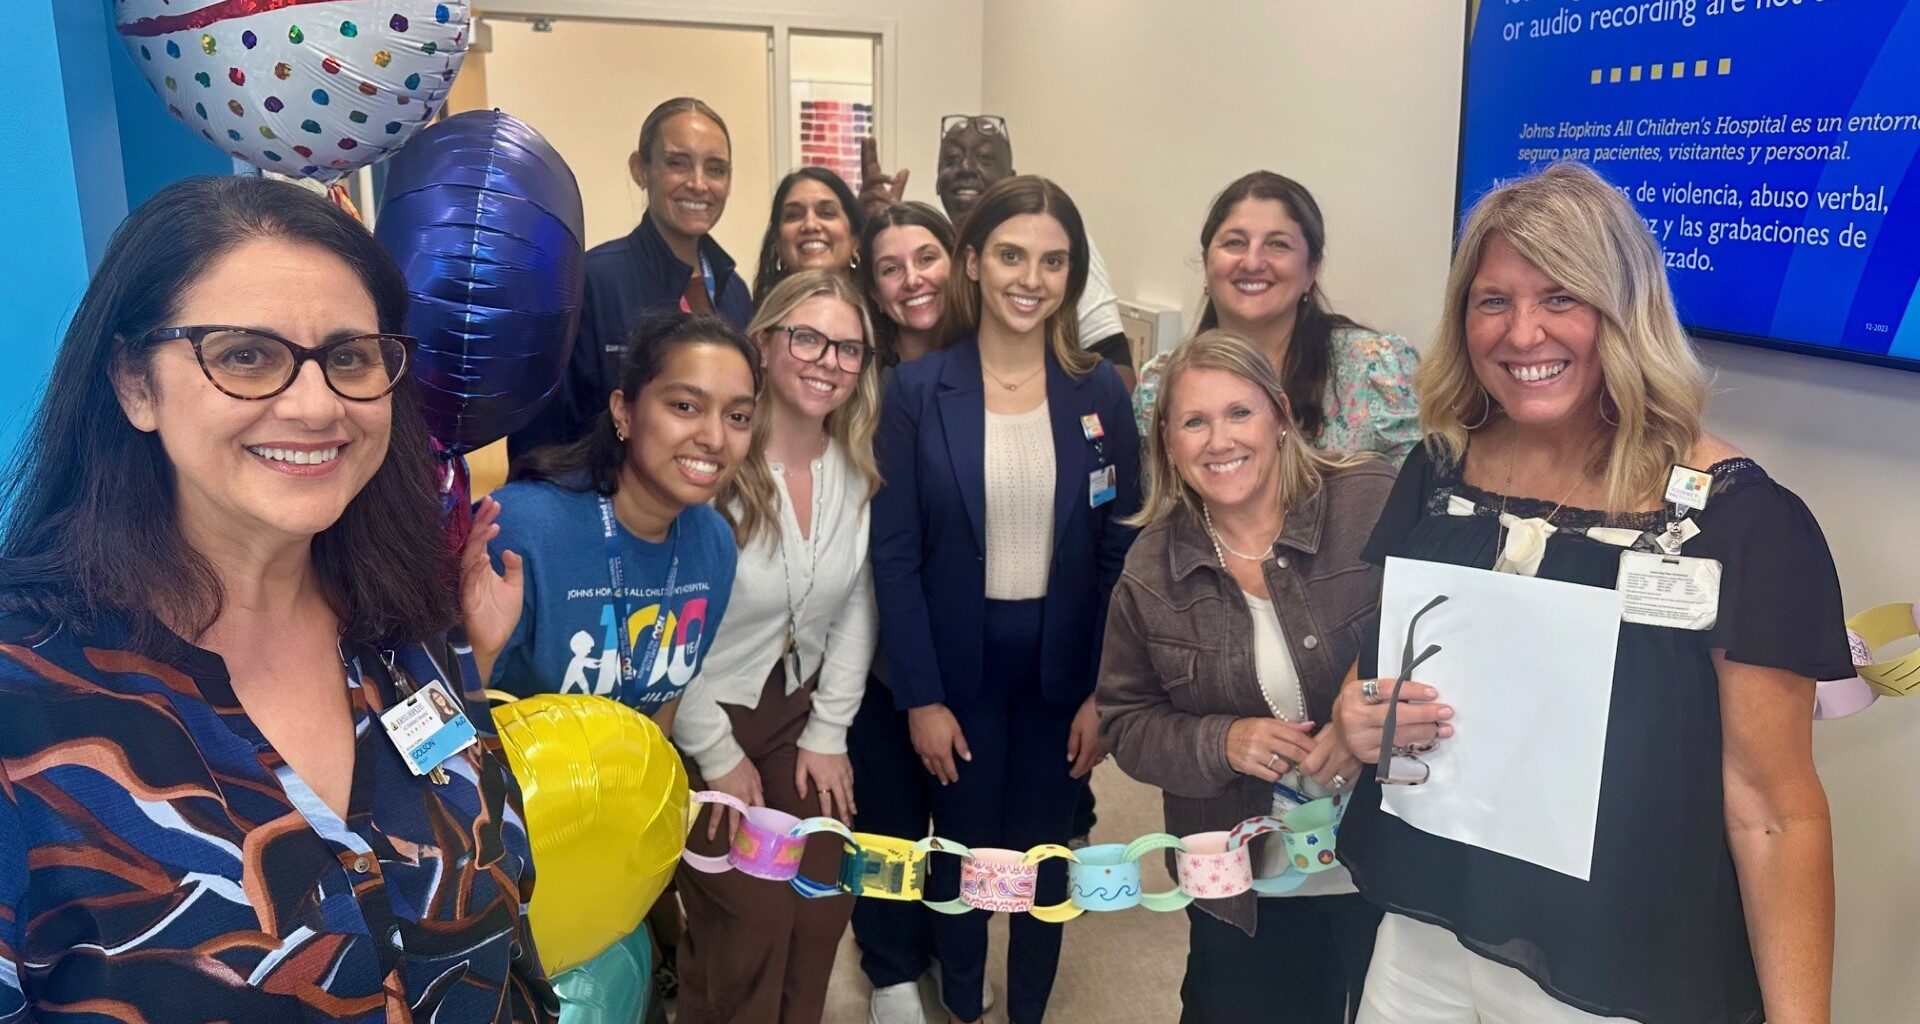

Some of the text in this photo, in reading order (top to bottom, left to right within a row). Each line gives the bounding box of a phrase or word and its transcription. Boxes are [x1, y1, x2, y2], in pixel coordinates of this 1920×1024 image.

[1503, 21, 1524, 41] or
[1529, 7, 1582, 38] audio
[1590, 0, 1697, 31] recording
[1519, 112, 1920, 141] Johns Hopkins All Children's Hospital es un entorn
[1518, 141, 1851, 165] seguro para pacientes, visitantes y personal.
[1636, 180, 1656, 203] de
[1662, 181, 1743, 209] violencia,
[1750, 183, 1809, 209] abuso
[1817, 185, 1888, 215] verbal,
[1663, 219, 1674, 241] y
[1680, 214, 1703, 237] las
[1707, 216, 1830, 246] grabaciones
[1838, 222, 1867, 249] de
[1865, 322, 1889, 333] 12-2023
[567, 588, 593, 600] JOHNS
[629, 588, 644, 597] ALL
[412, 739, 436, 758] GOLSON
